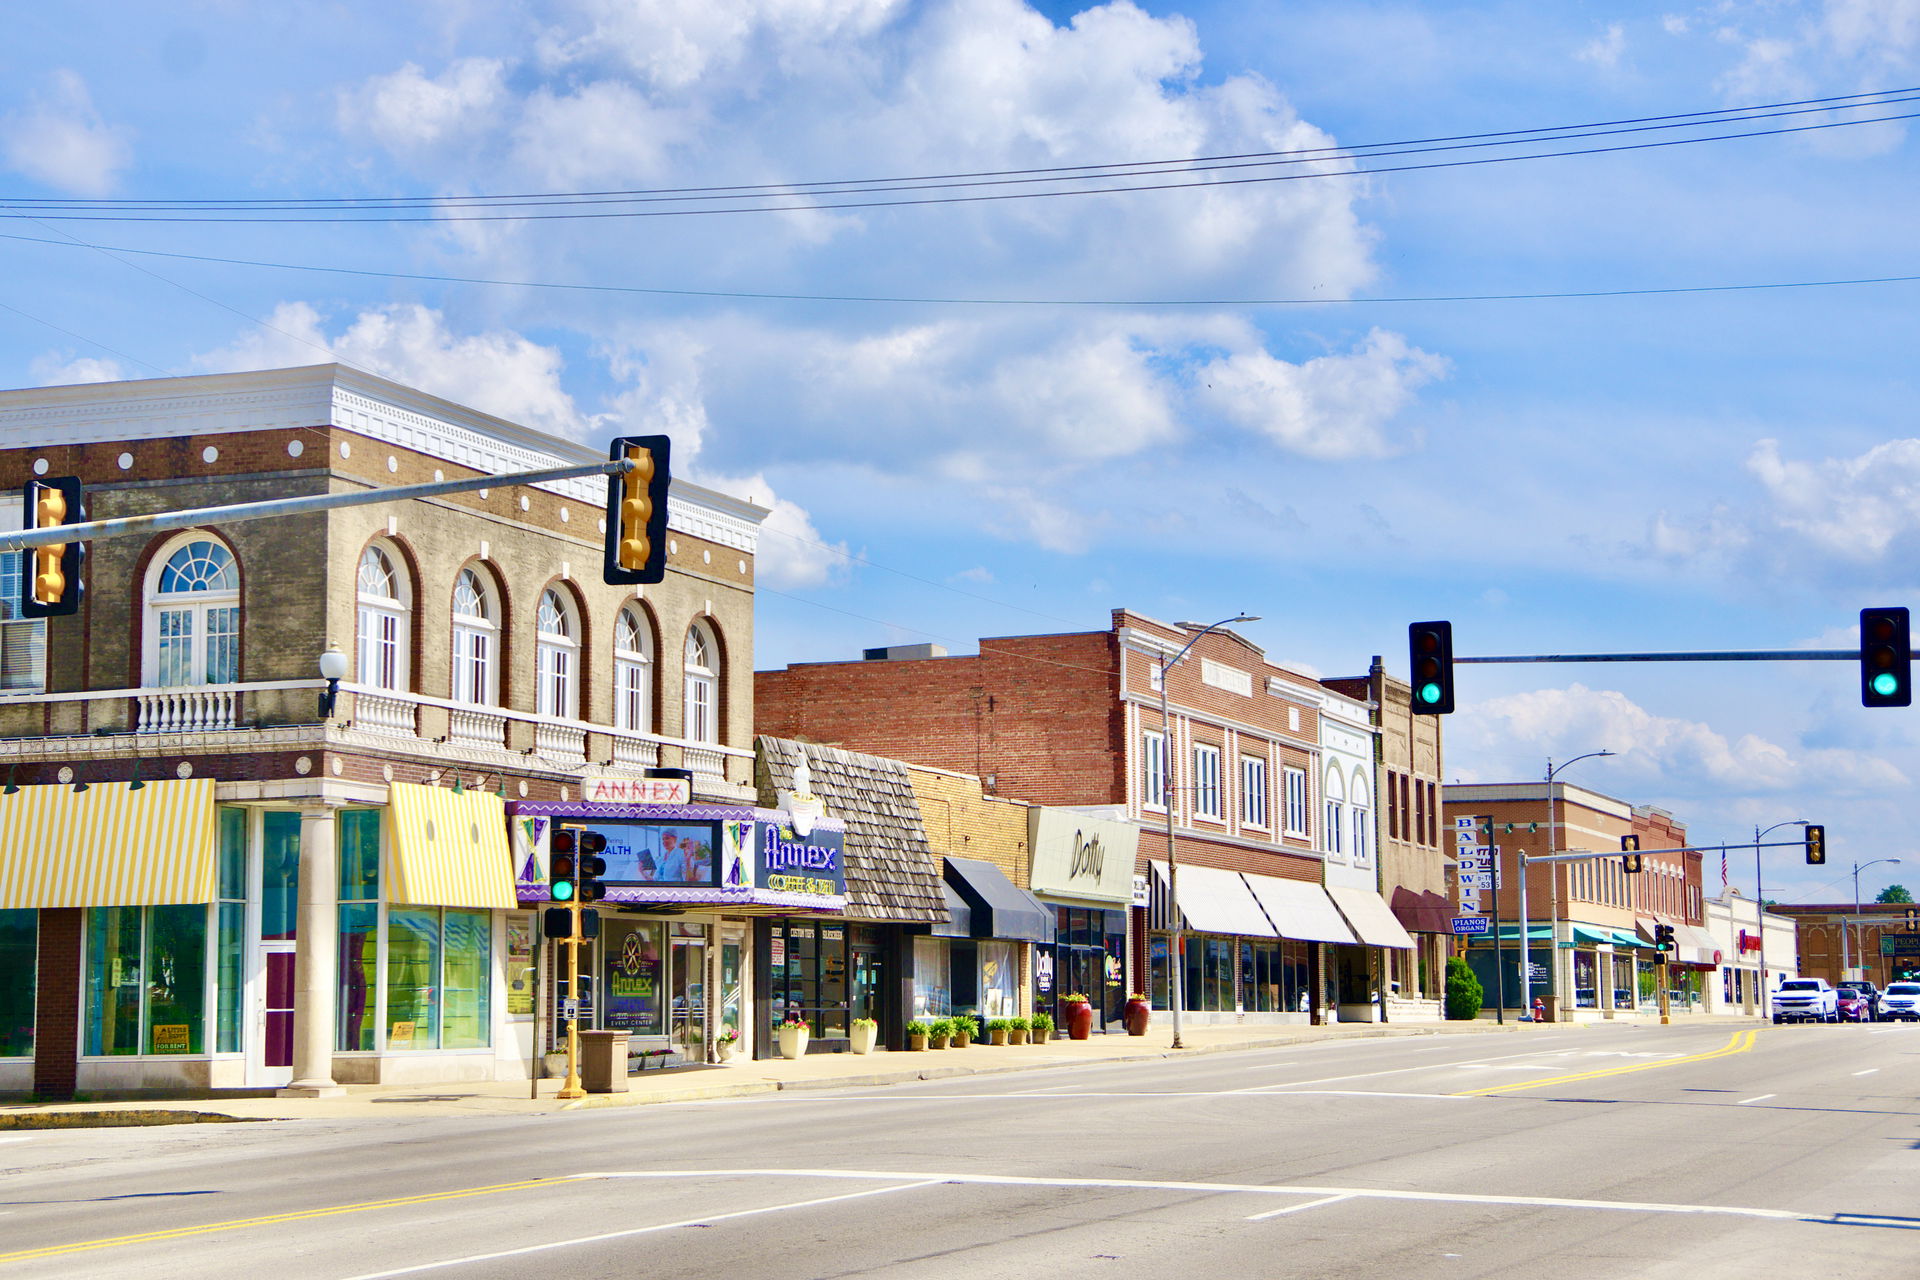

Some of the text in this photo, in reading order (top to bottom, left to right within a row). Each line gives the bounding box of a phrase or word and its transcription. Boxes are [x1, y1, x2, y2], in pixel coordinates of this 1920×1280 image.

[594, 780, 681, 801] ANNEX
[764, 824, 838, 871] Annex
[1069, 829, 1105, 887] Dotty
[1458, 819, 1475, 911] BALDWIN
[806, 878, 816, 893] &
[611, 970, 653, 997] Annex
